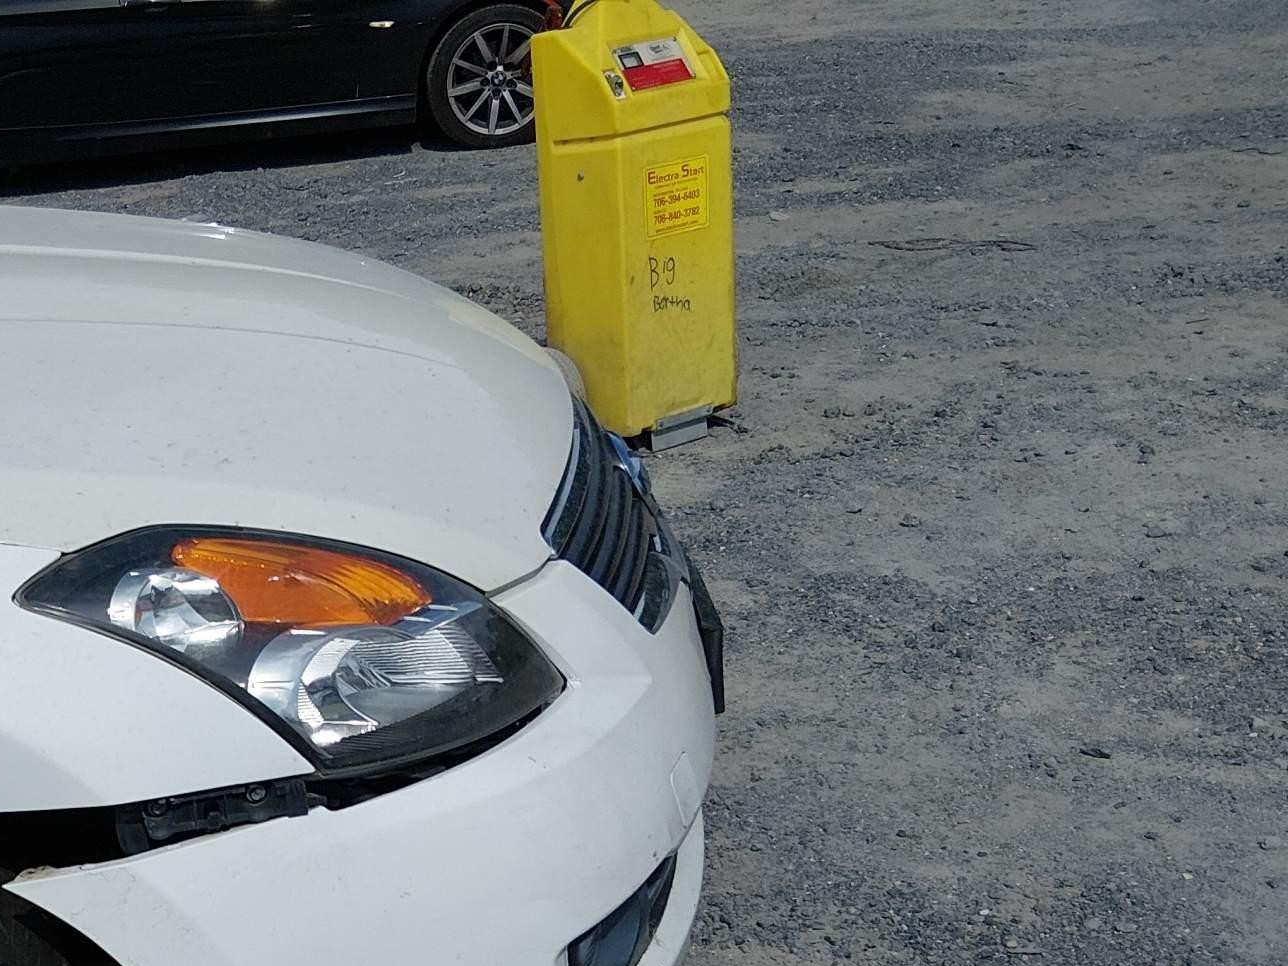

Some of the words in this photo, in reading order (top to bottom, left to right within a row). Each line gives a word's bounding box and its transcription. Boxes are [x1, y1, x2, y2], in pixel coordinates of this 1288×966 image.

[648, 171, 679, 185] Electra
[681, 164, 704, 178] Start
[648, 257, 676, 292] Big
